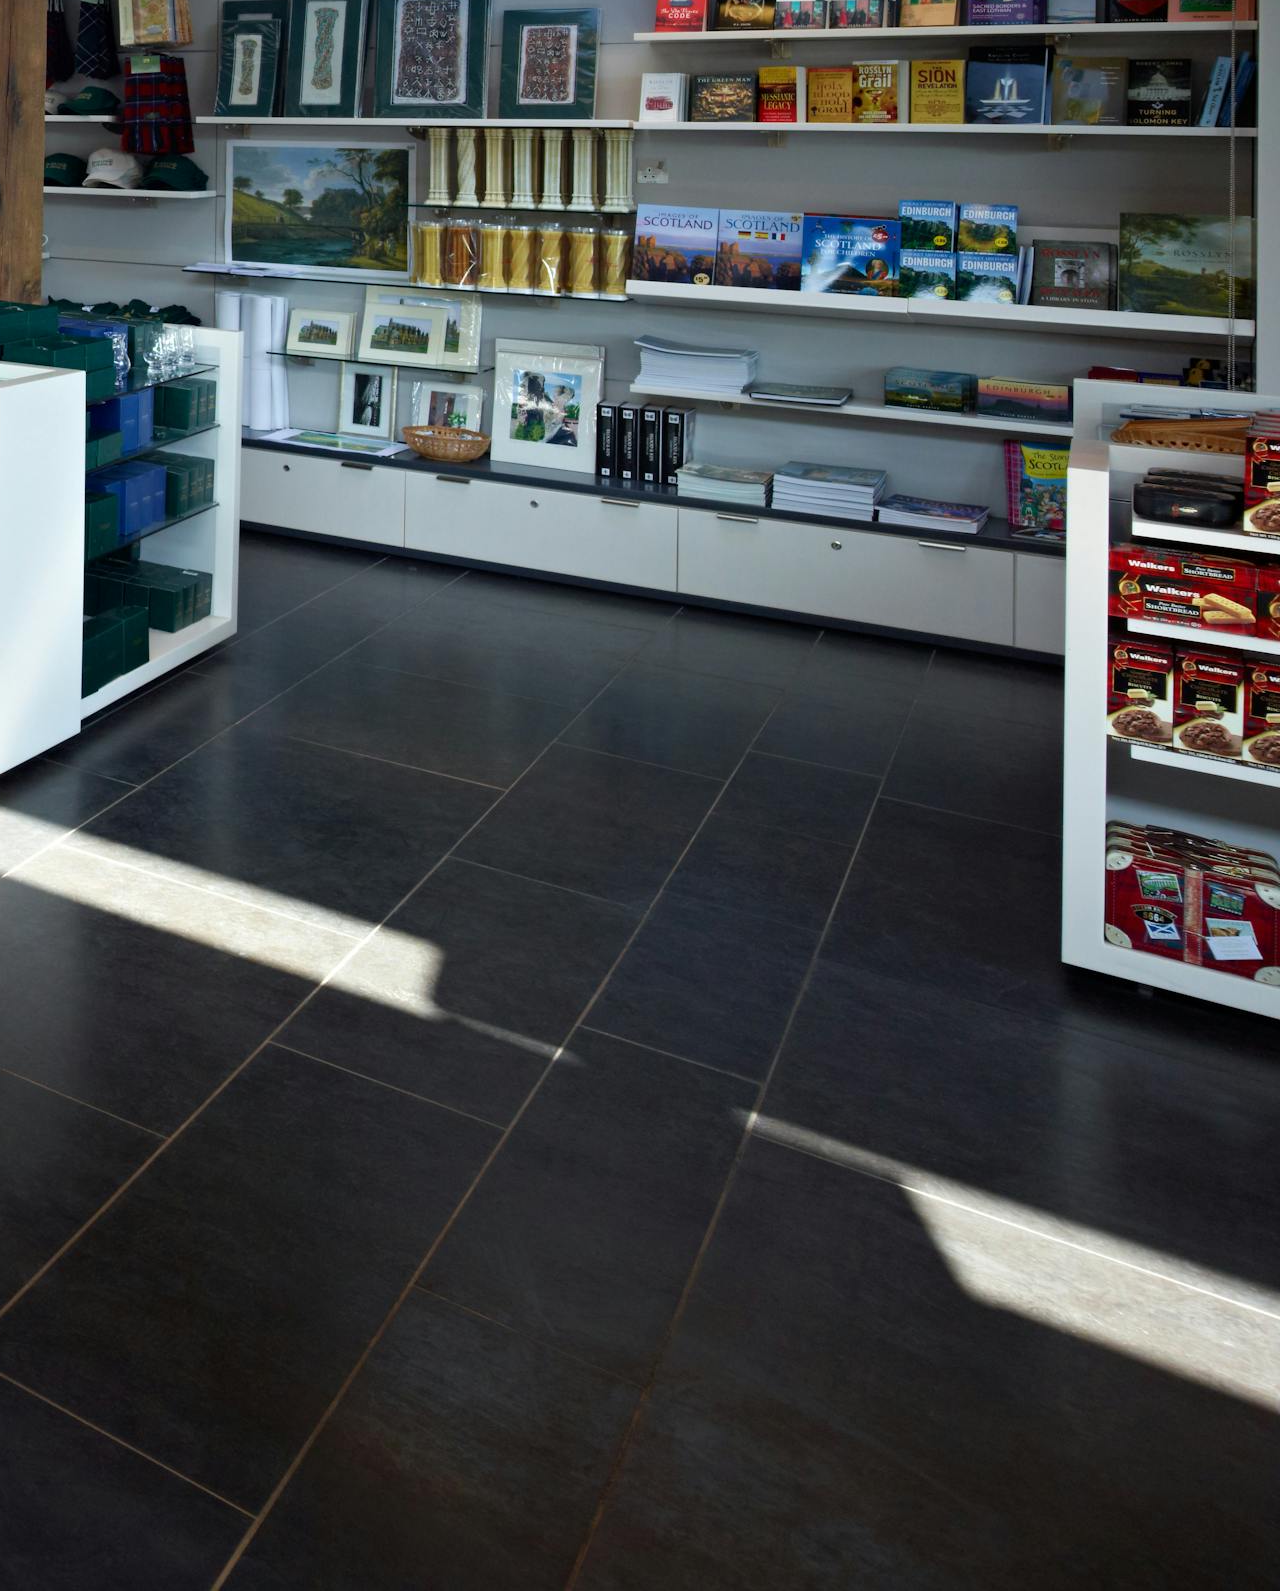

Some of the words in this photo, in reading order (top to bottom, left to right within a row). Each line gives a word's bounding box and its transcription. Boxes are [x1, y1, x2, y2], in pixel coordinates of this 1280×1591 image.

[858, 65, 892, 74] ROSSLYN
[858, 73, 892, 89] Grail
[918, 70, 956, 83] SION
[761, 92, 796, 101] MESSIANIC
[820, 98, 847, 106] HOLY
[763, 99, 792, 110] LEGACY
[817, 104, 850, 113] GRAIL
[901, 206, 952, 217] EDINBURGH
[963, 209, 1015, 221] EDINBURGH
[643, 216, 713, 230] SCOTLAND
[726, 218, 800, 233] SCOTLAND
[815, 238, 881, 251] SCOTLAND
[837, 249, 876, 257] CHILDREN
[902, 256, 953, 268] EDINBURGH
[962, 260, 1015, 272] EDINBURGH
[985, 383, 1052, 396] EDINBURGH
[1032, 451, 1046, 459] The
[1128, 559, 1176, 572] Walkers
[1183, 567, 1234, 580] SHORTBREAD
[1145, 583, 1201, 598] Walkers
[1145, 602, 1200, 616] SHORTBREAD
[1129, 652, 1168, 665] Walkers
[1198, 664, 1238, 677] Walkers
[1127, 681, 1153, 690] BISCUITS
[1196, 693, 1222, 702] BISCUITS
